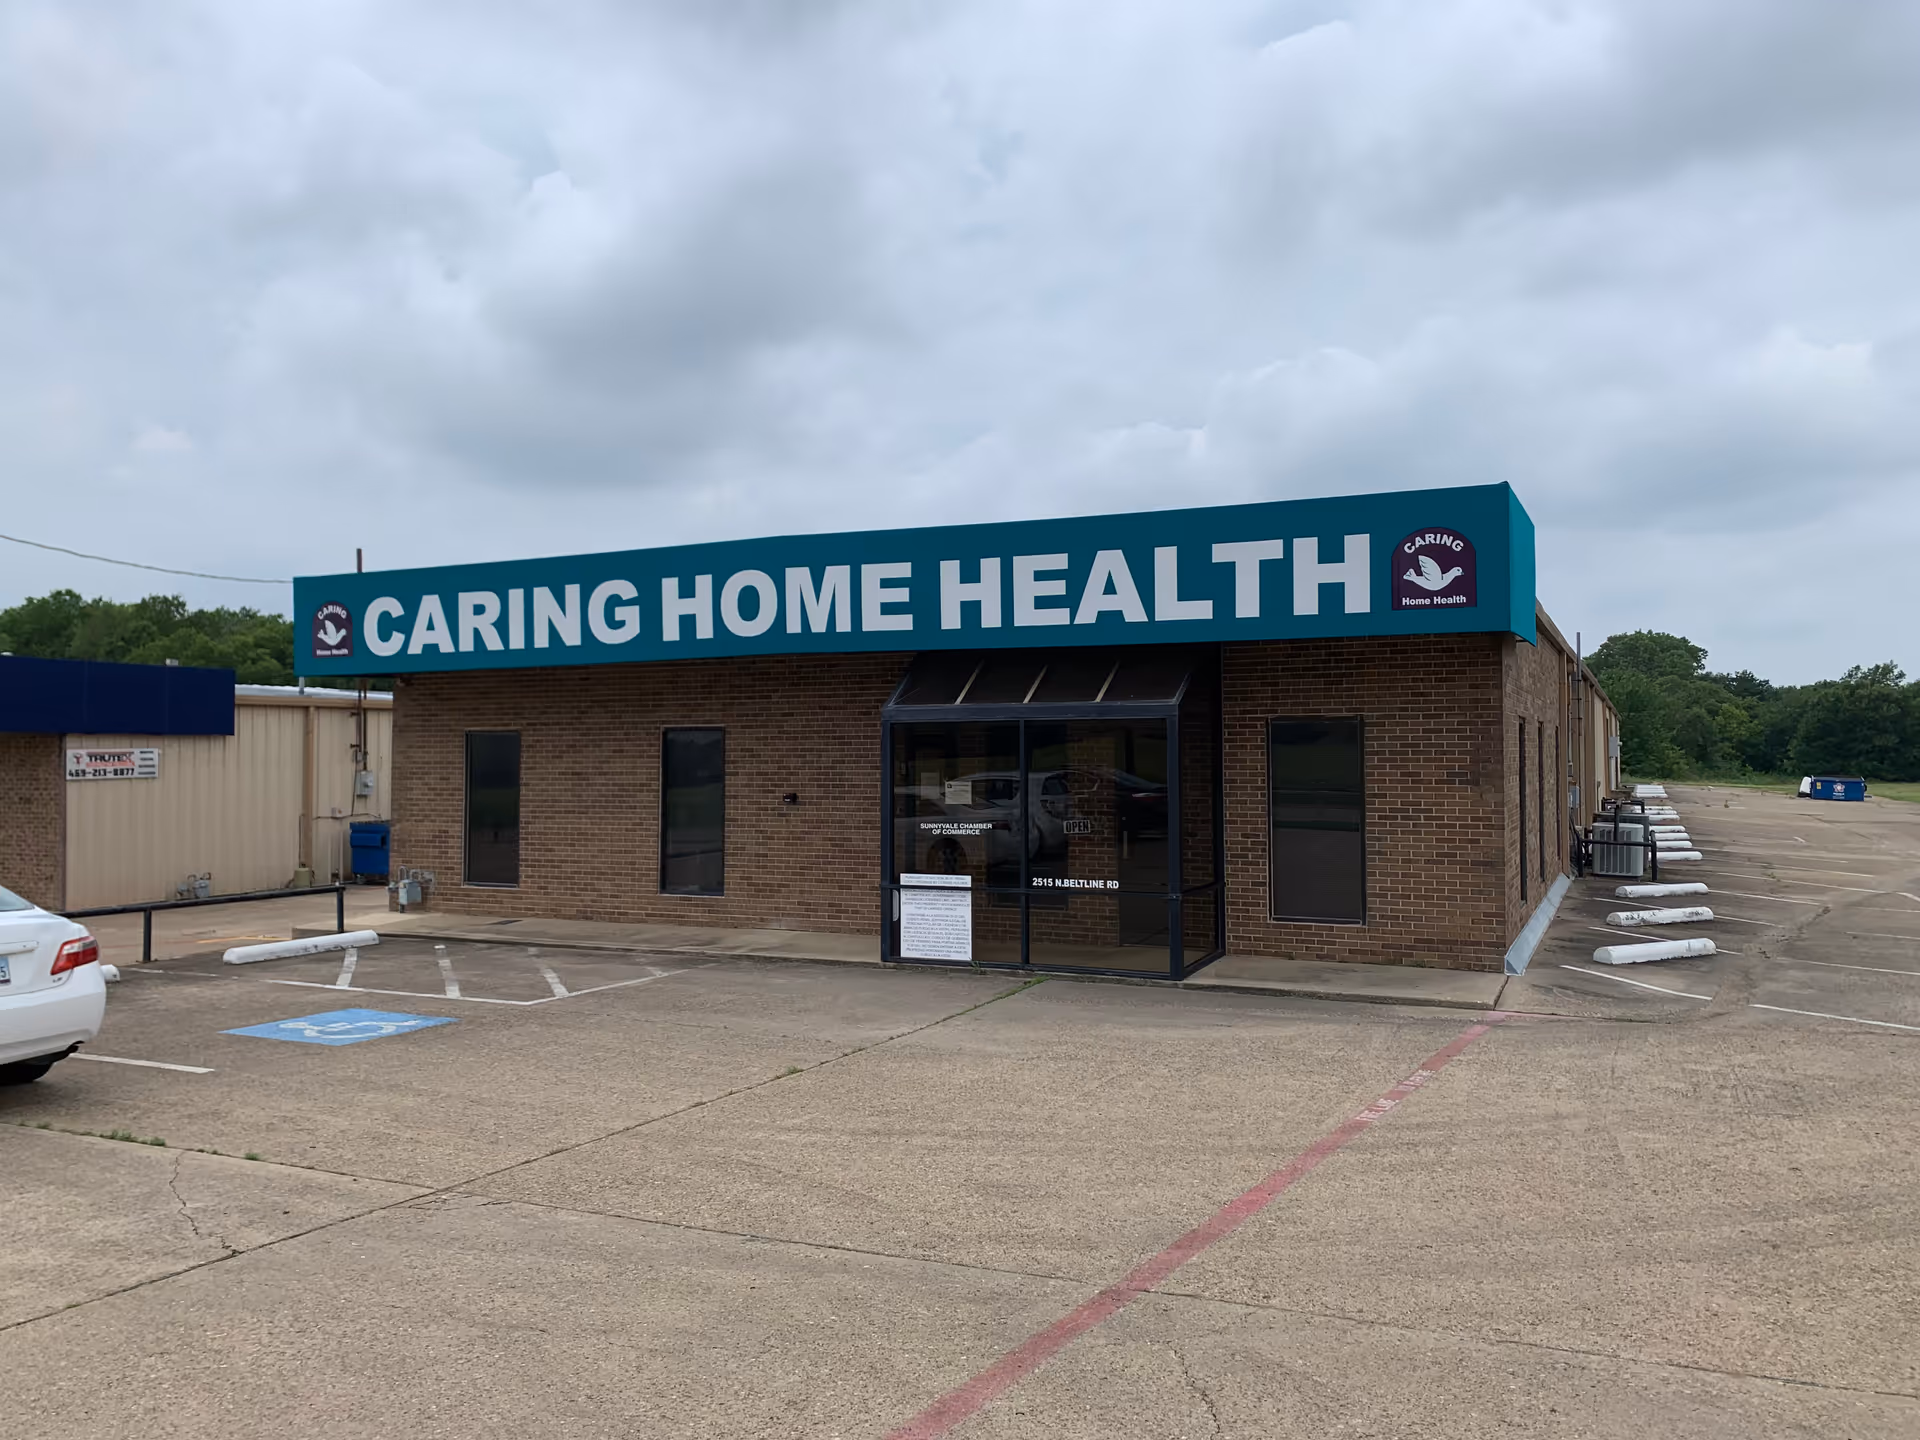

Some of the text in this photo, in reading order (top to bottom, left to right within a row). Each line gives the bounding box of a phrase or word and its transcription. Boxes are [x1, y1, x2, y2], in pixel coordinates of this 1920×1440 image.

[1403, 533, 1464, 553] CARING
[363, 533, 1371, 657] CARING HOME HEALTH
[1402, 595, 1467, 606] Home Health
[317, 604, 347, 620] CARING
[1065, 821, 1090, 833] OPEN
[1032, 878, 1120, 889] 2515 N.BELTLINE RD
